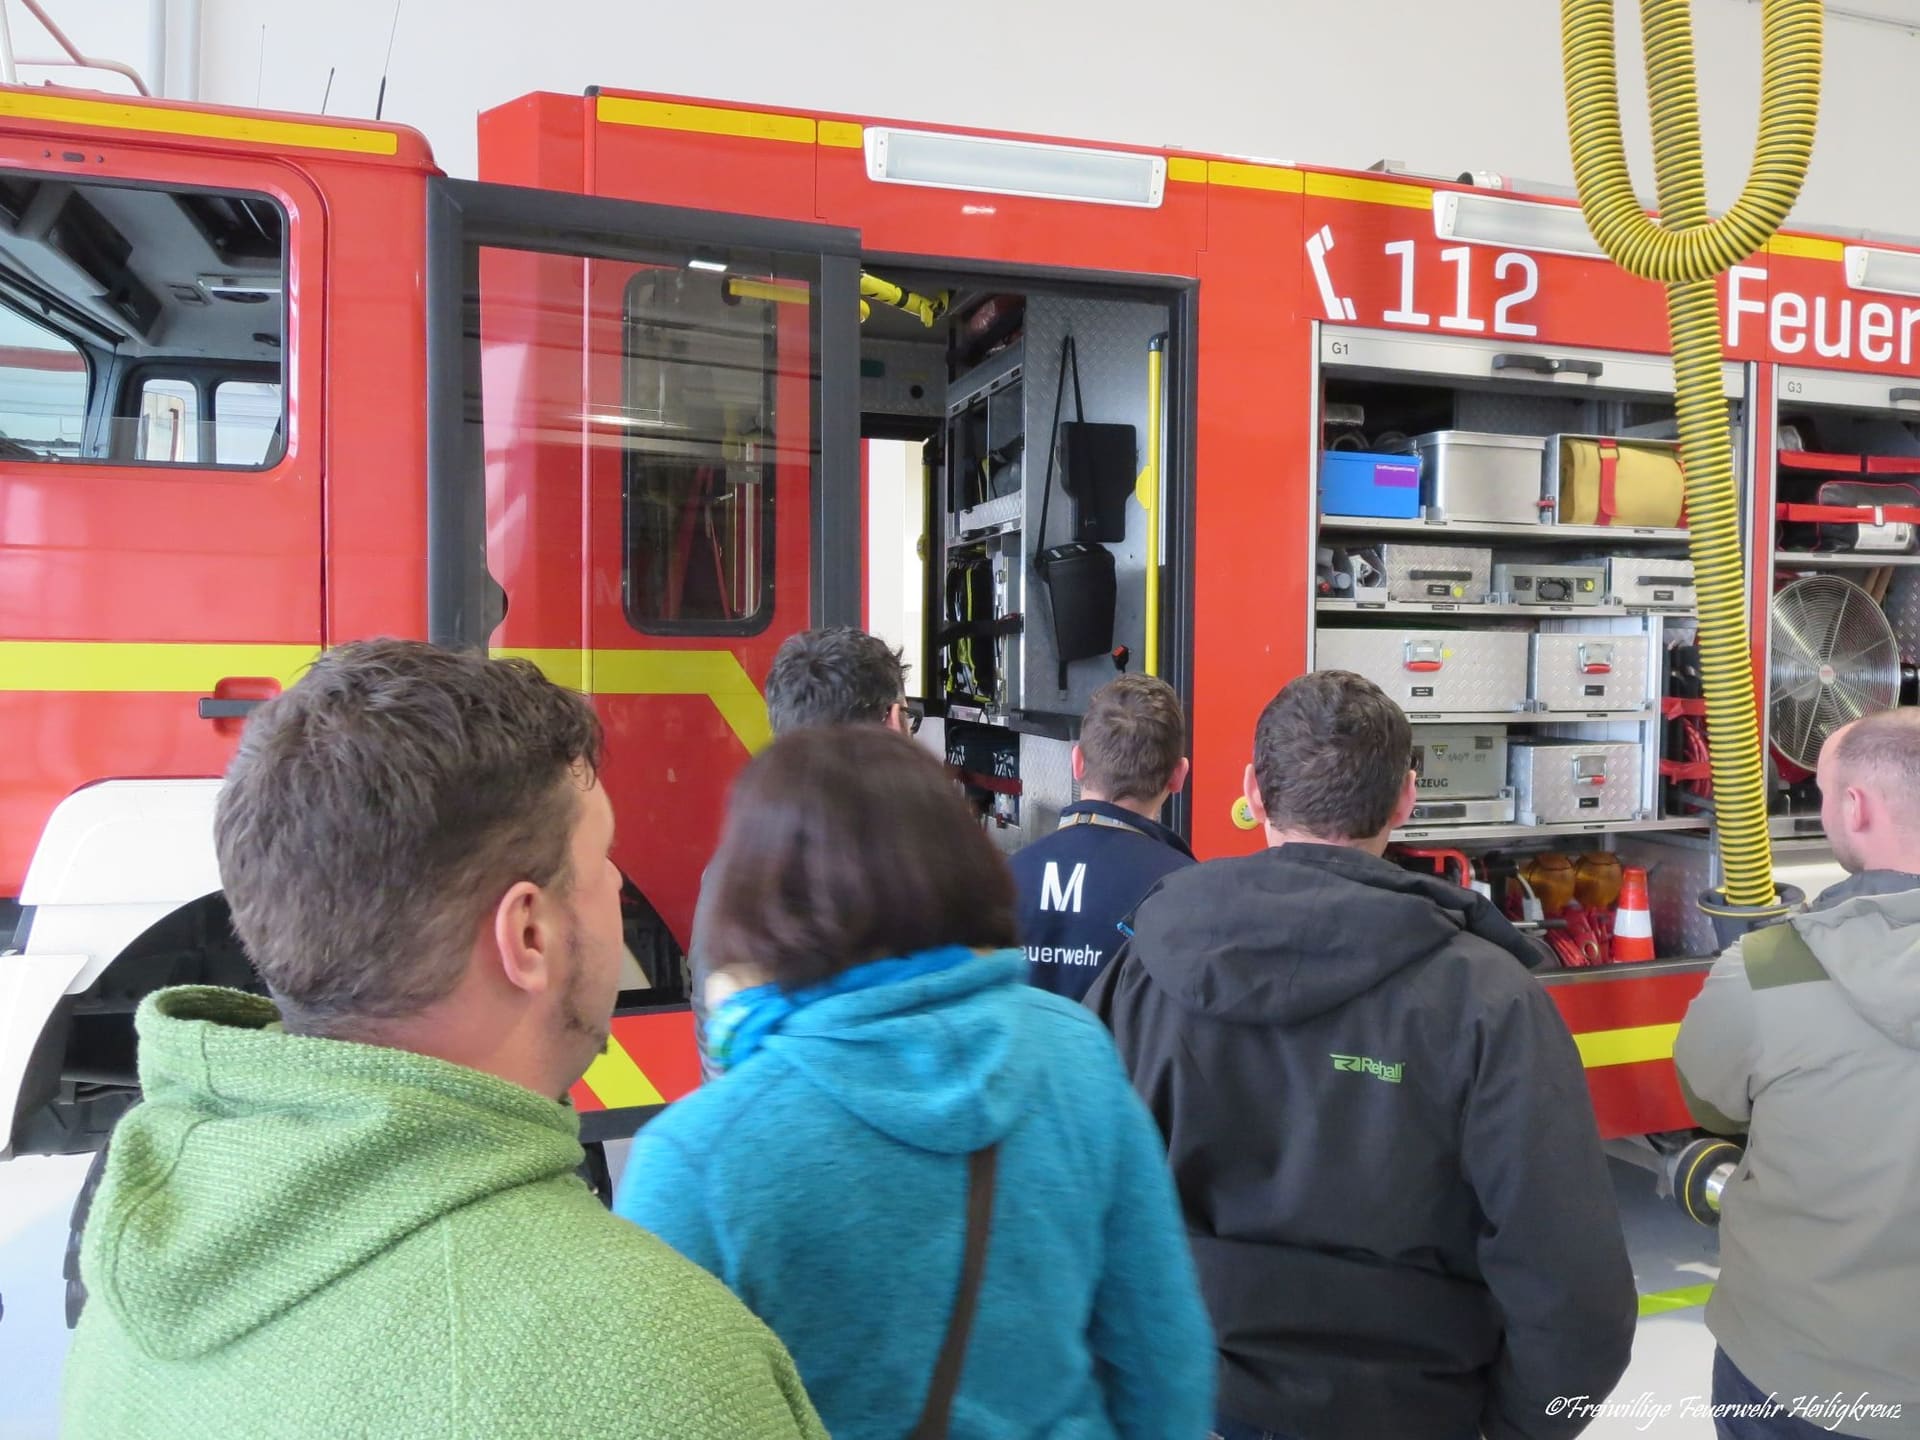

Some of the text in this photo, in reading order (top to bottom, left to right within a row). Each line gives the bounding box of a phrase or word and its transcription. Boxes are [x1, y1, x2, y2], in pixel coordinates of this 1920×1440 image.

[1383, 239, 1538, 336] 112
[1727, 265, 1920, 365] Feuer
[1331, 341, 1349, 355] G1
[1787, 380, 1802, 394] G3
[1040, 861, 1087, 913] M
[1361, 1056, 1402, 1079] Rehall
